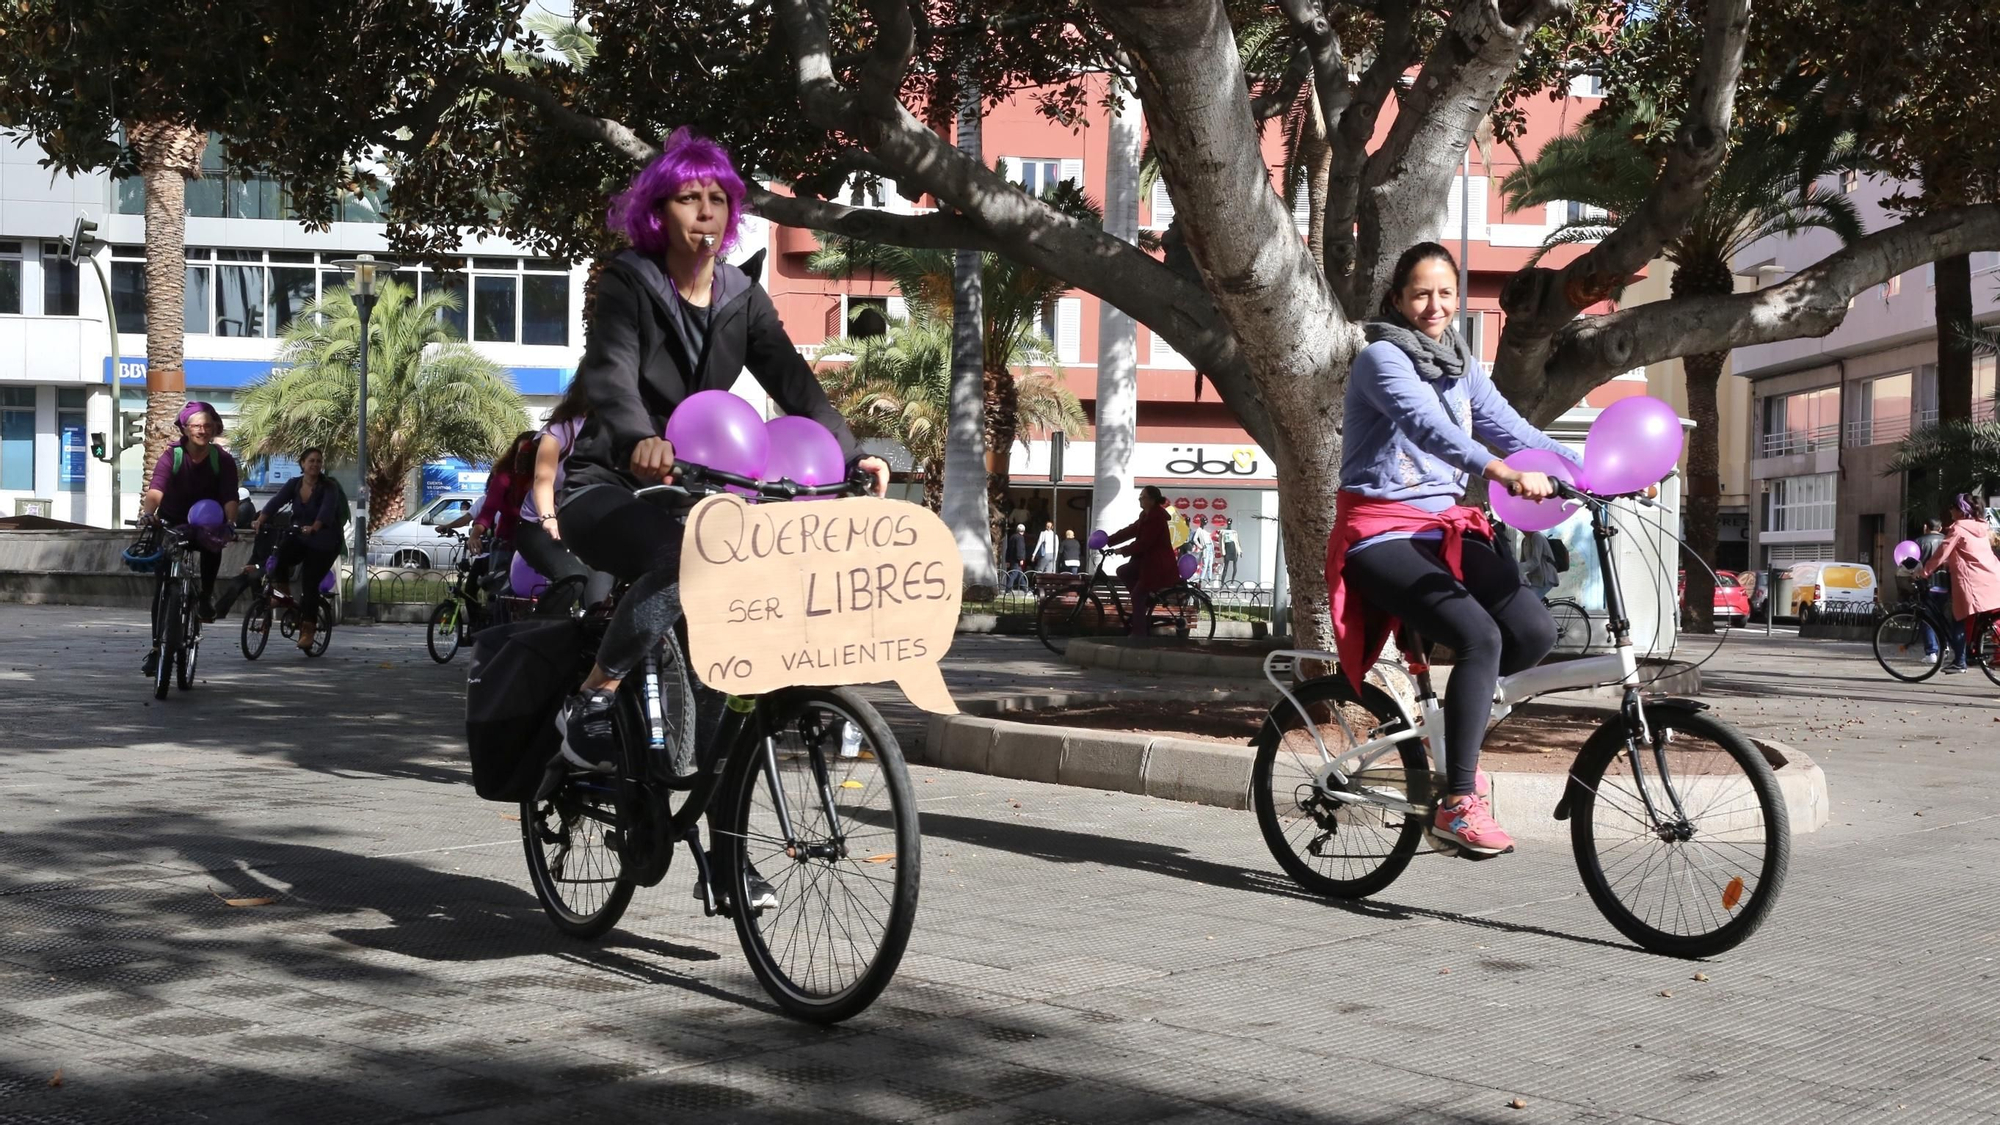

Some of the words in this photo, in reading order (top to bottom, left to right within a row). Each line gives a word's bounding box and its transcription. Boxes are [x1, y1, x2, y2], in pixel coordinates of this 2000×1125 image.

[695, 497, 918, 565] QUEREMOS
[727, 597, 784, 624] SER
[805, 561, 952, 618] LIBRES,
[708, 655, 752, 683] NO
[781, 638, 928, 671] VALIENTES
